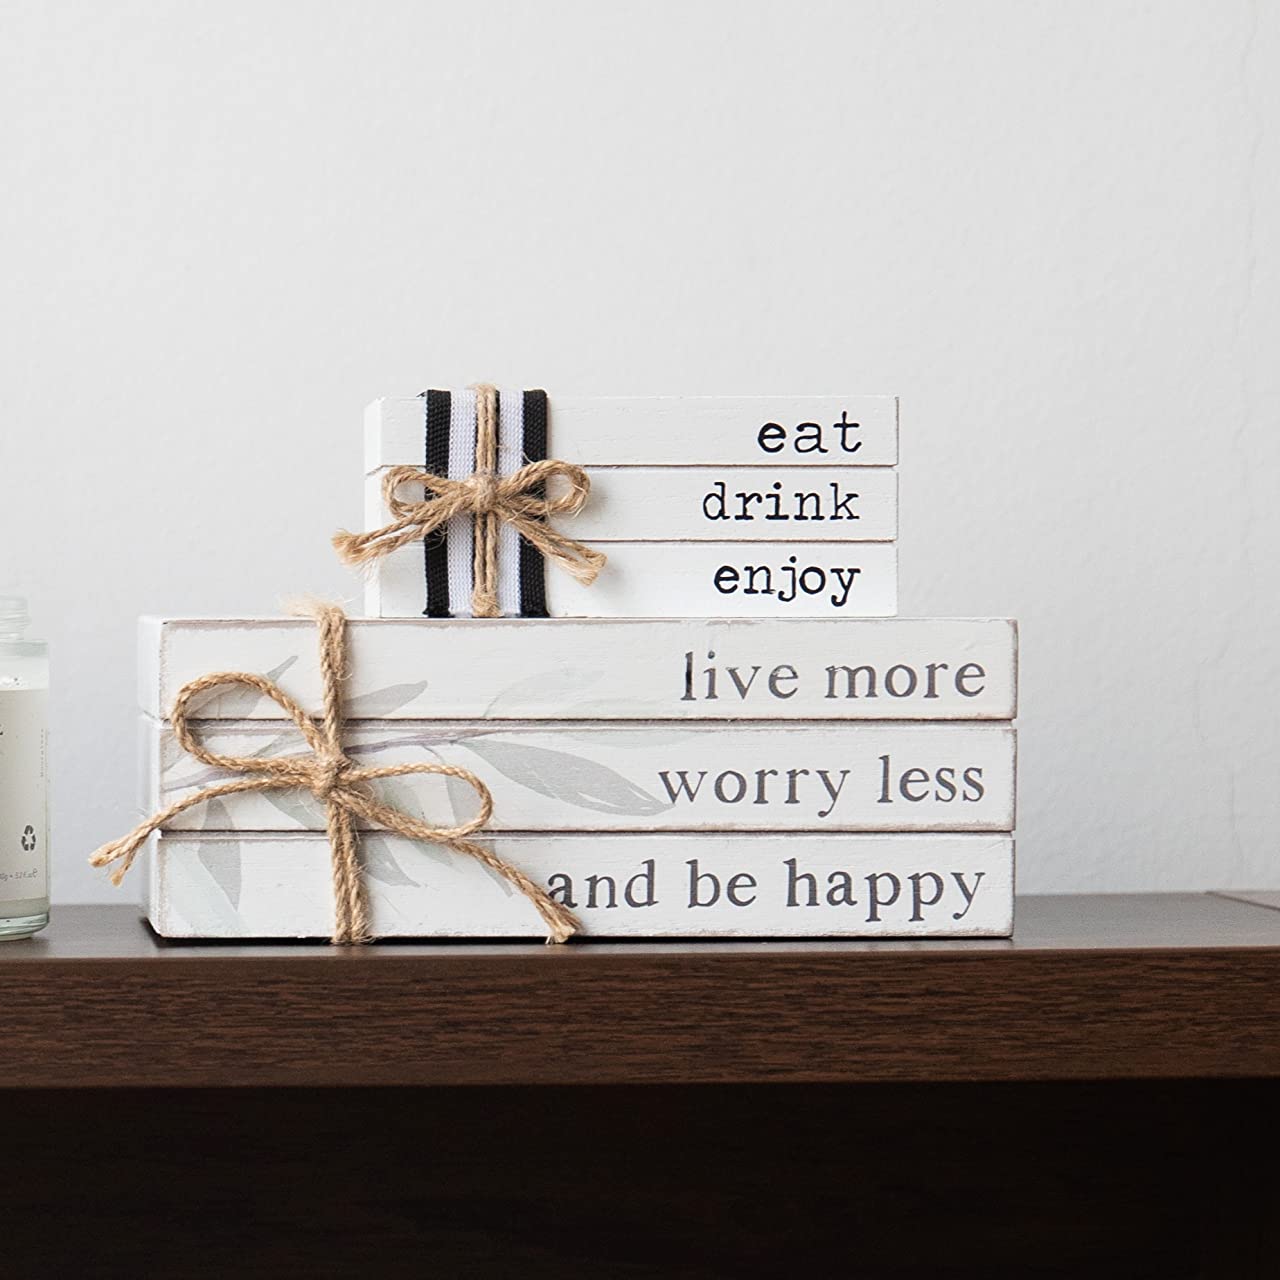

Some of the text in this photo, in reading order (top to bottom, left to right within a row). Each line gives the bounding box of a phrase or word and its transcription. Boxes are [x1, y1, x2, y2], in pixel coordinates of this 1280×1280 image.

[758, 411, 862, 453] eat
[703, 482, 860, 520] drink
[714, 556, 861, 607] enjoy
[680, 650, 985, 701] live more
[658, 755, 984, 817] worry less
[548, 858, 985, 922] and be happy
